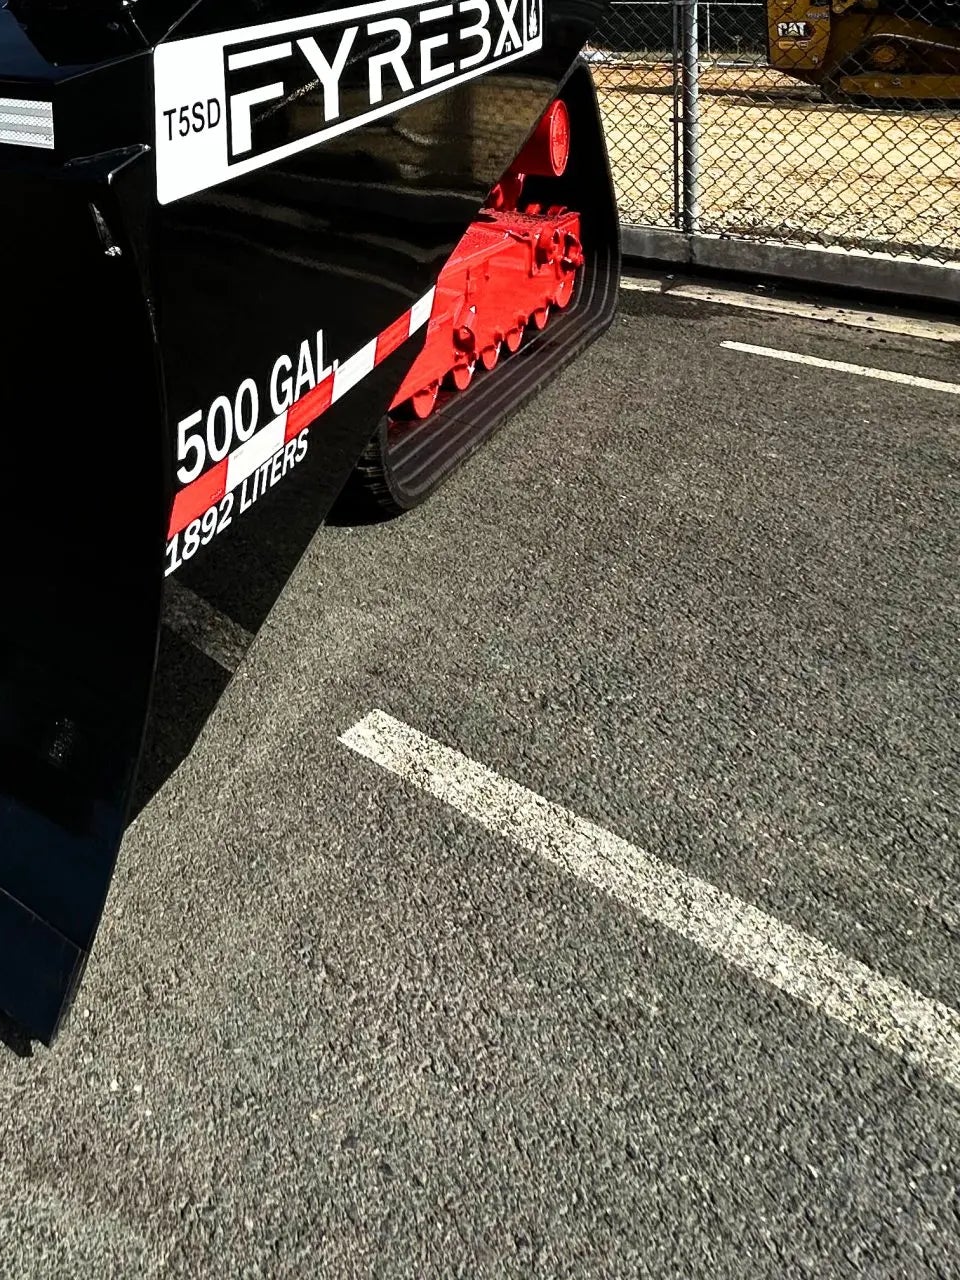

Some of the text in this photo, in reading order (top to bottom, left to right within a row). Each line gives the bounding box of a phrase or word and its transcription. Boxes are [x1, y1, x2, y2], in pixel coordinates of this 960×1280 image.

[777, 22, 807, 37] CAT
[163, 97, 222, 141] T5SD
[176, 377, 259, 484] 500
[164, 427, 310, 578] 1892 LITERS
